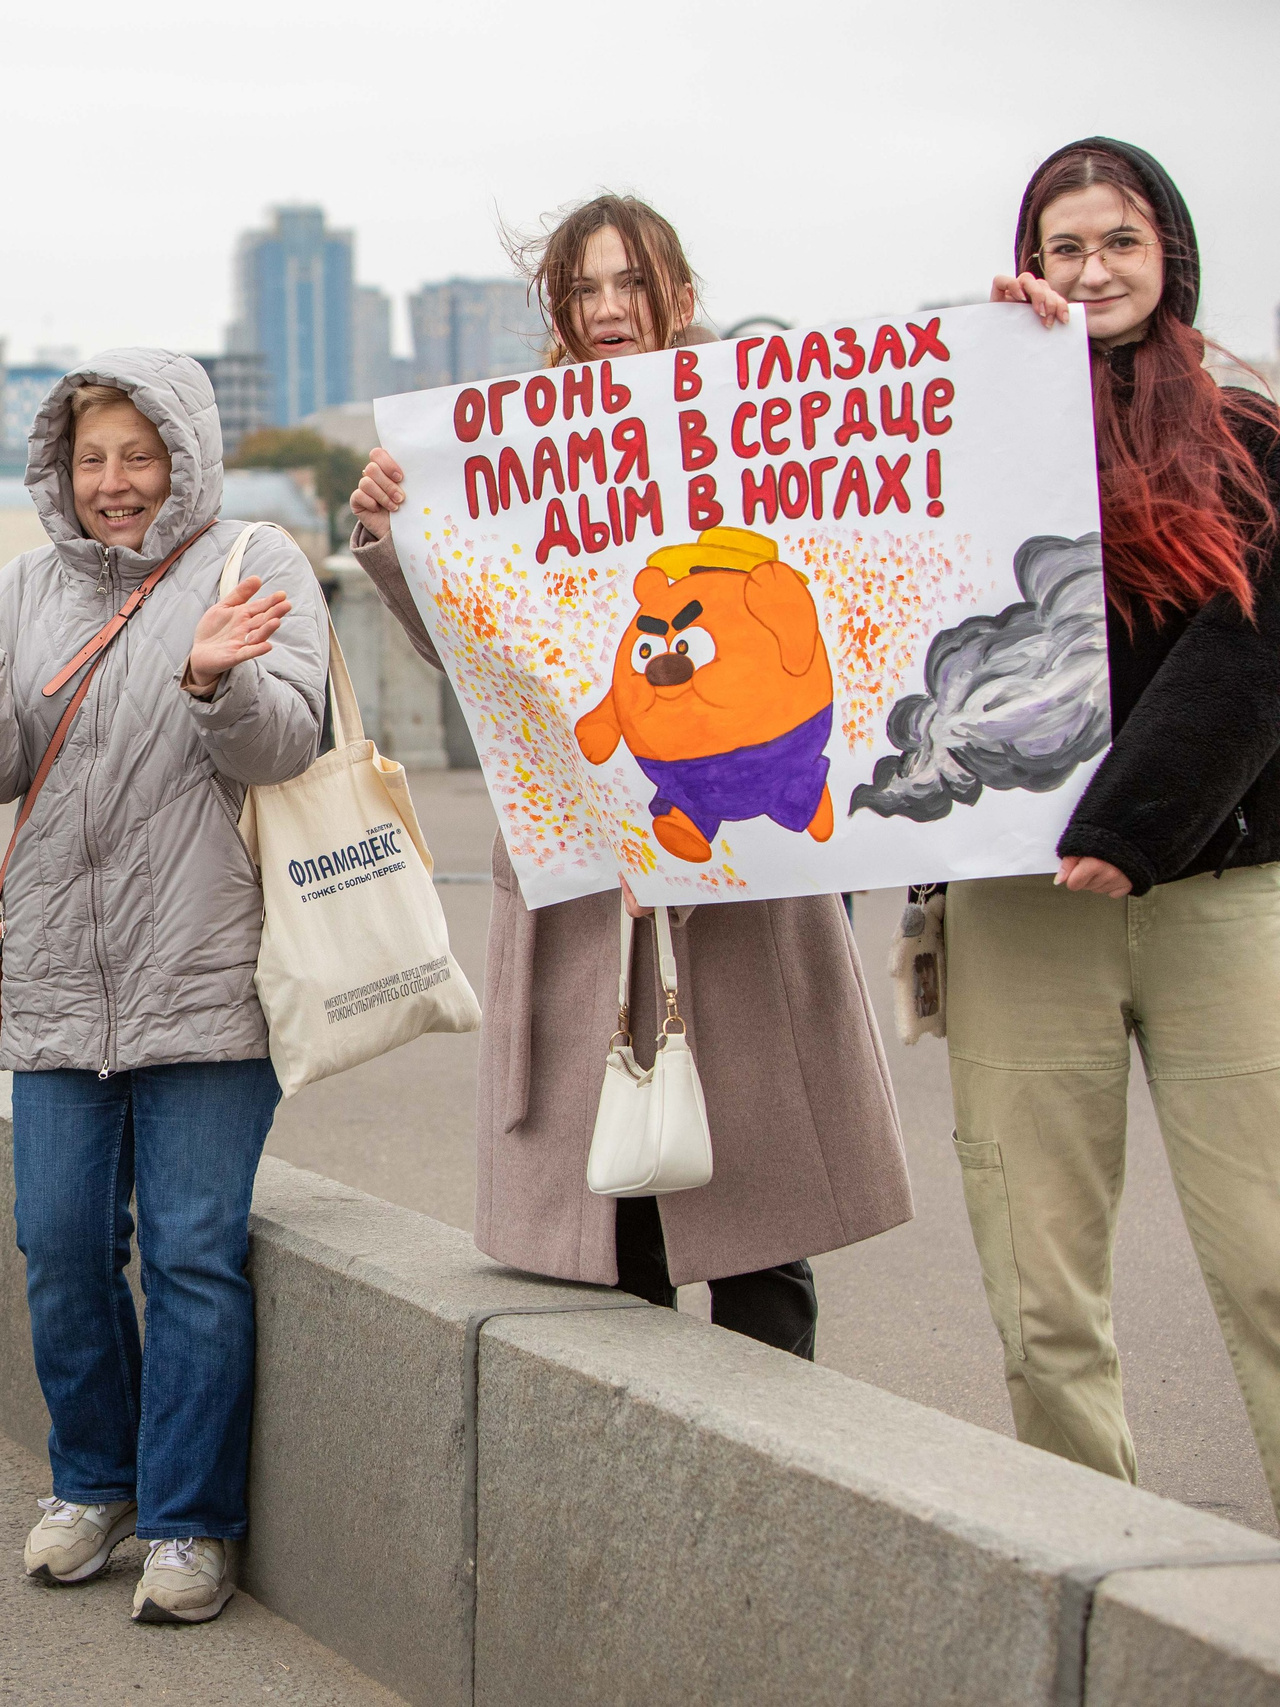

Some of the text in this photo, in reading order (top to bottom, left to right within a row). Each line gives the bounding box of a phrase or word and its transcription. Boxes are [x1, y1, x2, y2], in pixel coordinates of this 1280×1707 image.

[454, 316, 951, 443] ОГОНЬ В ГЛАЗАХ
[464, 418, 650, 520] ПЛАМЯ
[679, 409, 718, 472] В
[535, 447, 945, 564] ДЫМ В НОГАХ!
[365, 822, 393, 836] ТАБЛЕТКИ
[301, 861, 407, 903] В ГОНКЕ С БОЛЬЮ ПЕРЕВЕС
[323, 993, 348, 1011] ИМЕЮТСЯ
[401, 967, 421, 982] ПЕРЕД
[327, 988, 400, 1024] ПРОКОНСУЛЬТИРУЙТЕСЬ
[400, 983, 410, 997] СО
